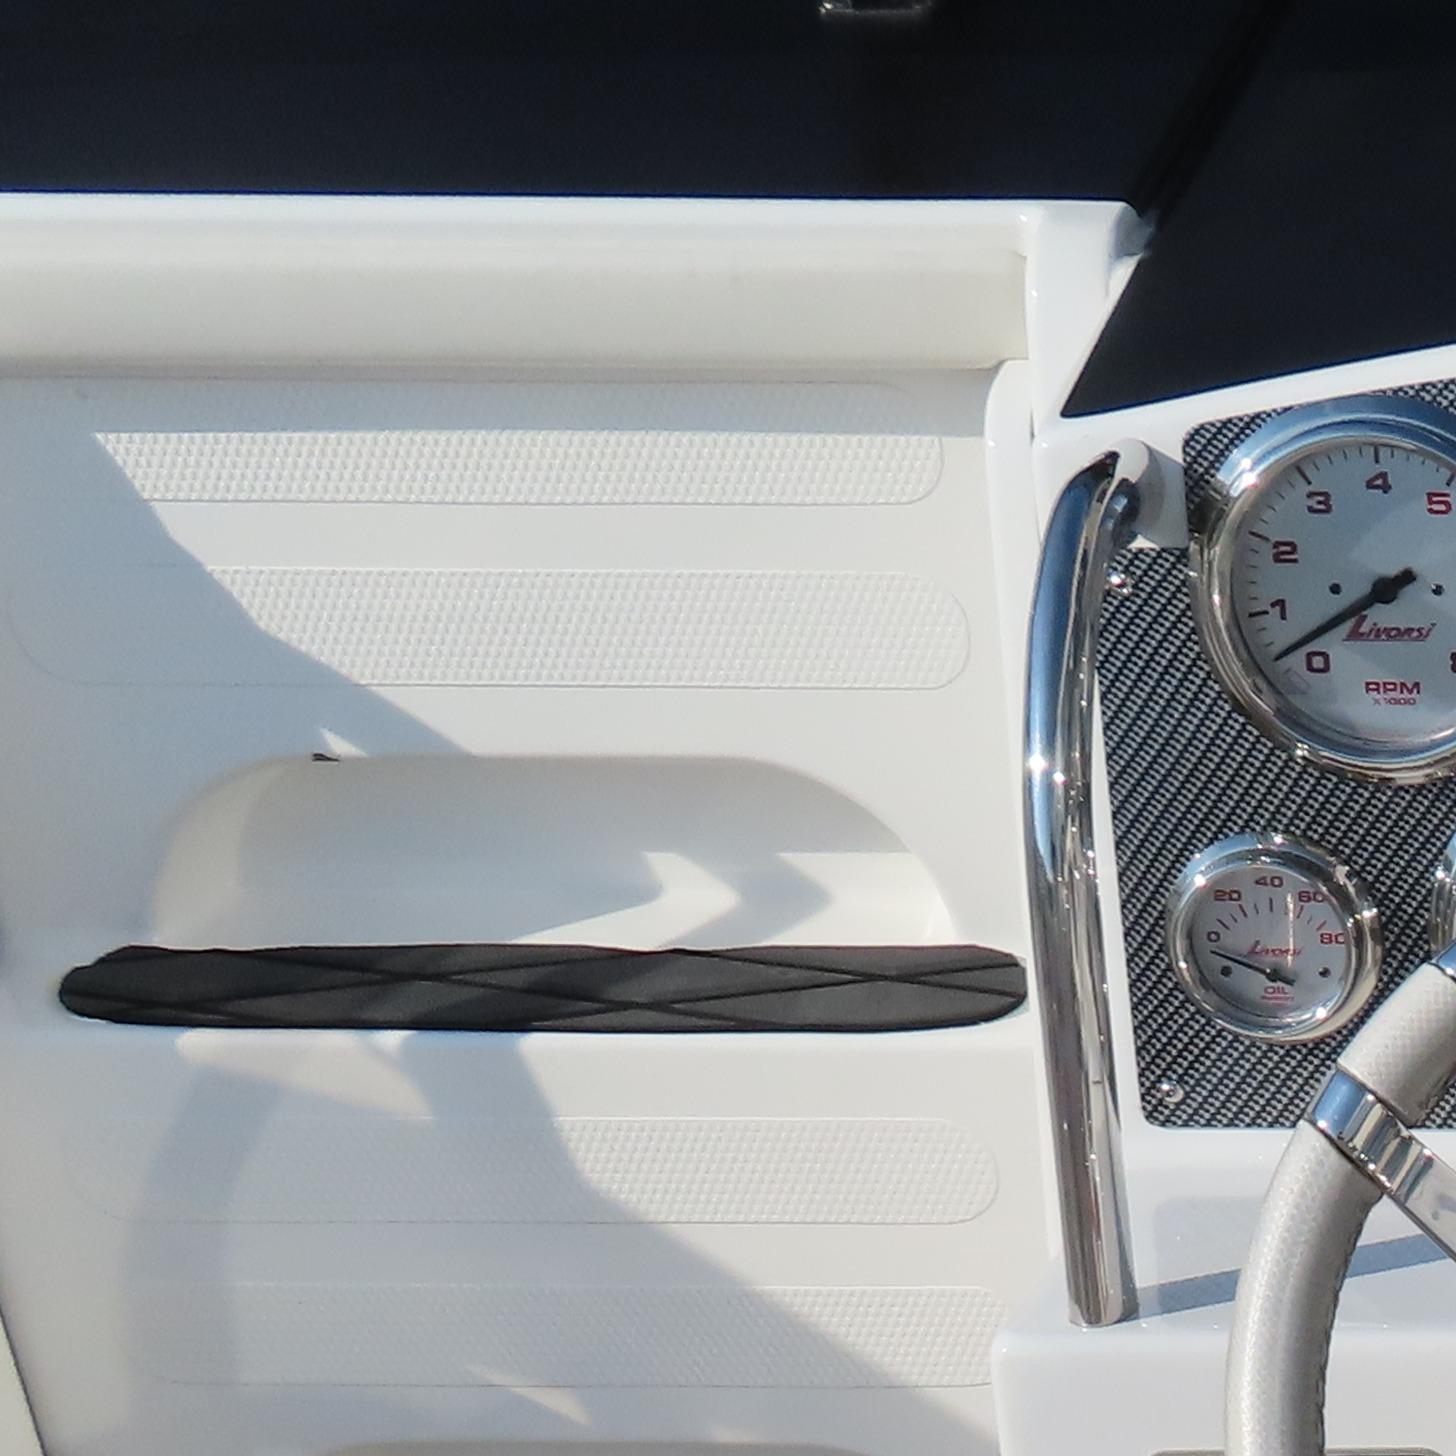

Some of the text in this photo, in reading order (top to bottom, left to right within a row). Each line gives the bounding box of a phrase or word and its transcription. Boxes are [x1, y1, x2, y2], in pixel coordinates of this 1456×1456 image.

[1366, 472, 1392, 494] 4
[1307, 492, 1332, 514] 3
[1426, 493, 1452, 515] 5
[1273, 541, 1298, 563] 2
[1271, 599, 1287, 620] 1
[1306, 651, 1330, 673] 0
[1365, 681, 1420, 695] RPM
[1254, 876, 1283, 888] 40
[1214, 890, 1241, 901] 20
[1207, 931, 1220, 942] 0
[1264, 986, 1289, 994] OIL
